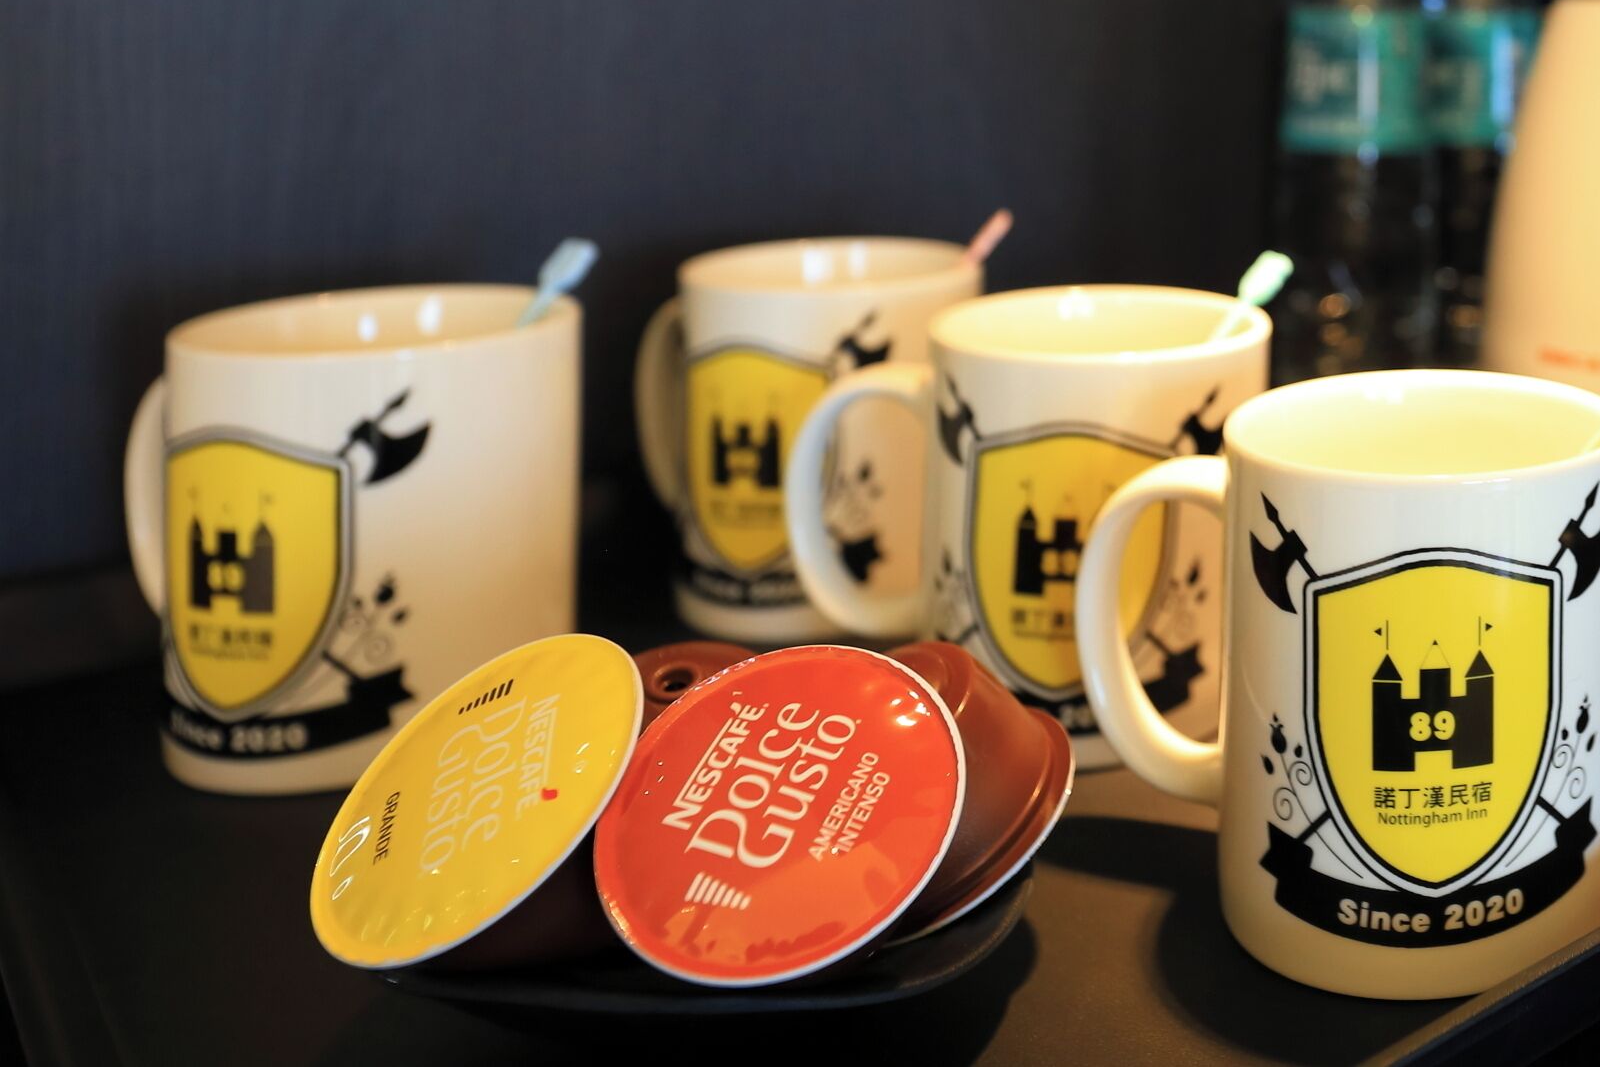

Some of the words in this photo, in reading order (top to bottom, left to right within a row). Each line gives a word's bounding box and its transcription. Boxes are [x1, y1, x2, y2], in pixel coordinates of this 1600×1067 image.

[1408, 710, 1456, 742] 89
[462, 695, 528, 852] Dolce
[684, 702, 820, 859] Dolce
[737, 714, 858, 869] Gusto
[808, 751, 879, 862] AMERICANO
[836, 771, 891, 853] INTENSO
[1373, 781, 1493, 809] 諾丁漢民宿
[373, 791, 400, 865] GRANDE
[1378, 811, 1463, 828] Nottingham
[1466, 807, 1489, 821] Inn
[1337, 897, 1431, 933] Since
[1444, 888, 1525, 931] 2020
